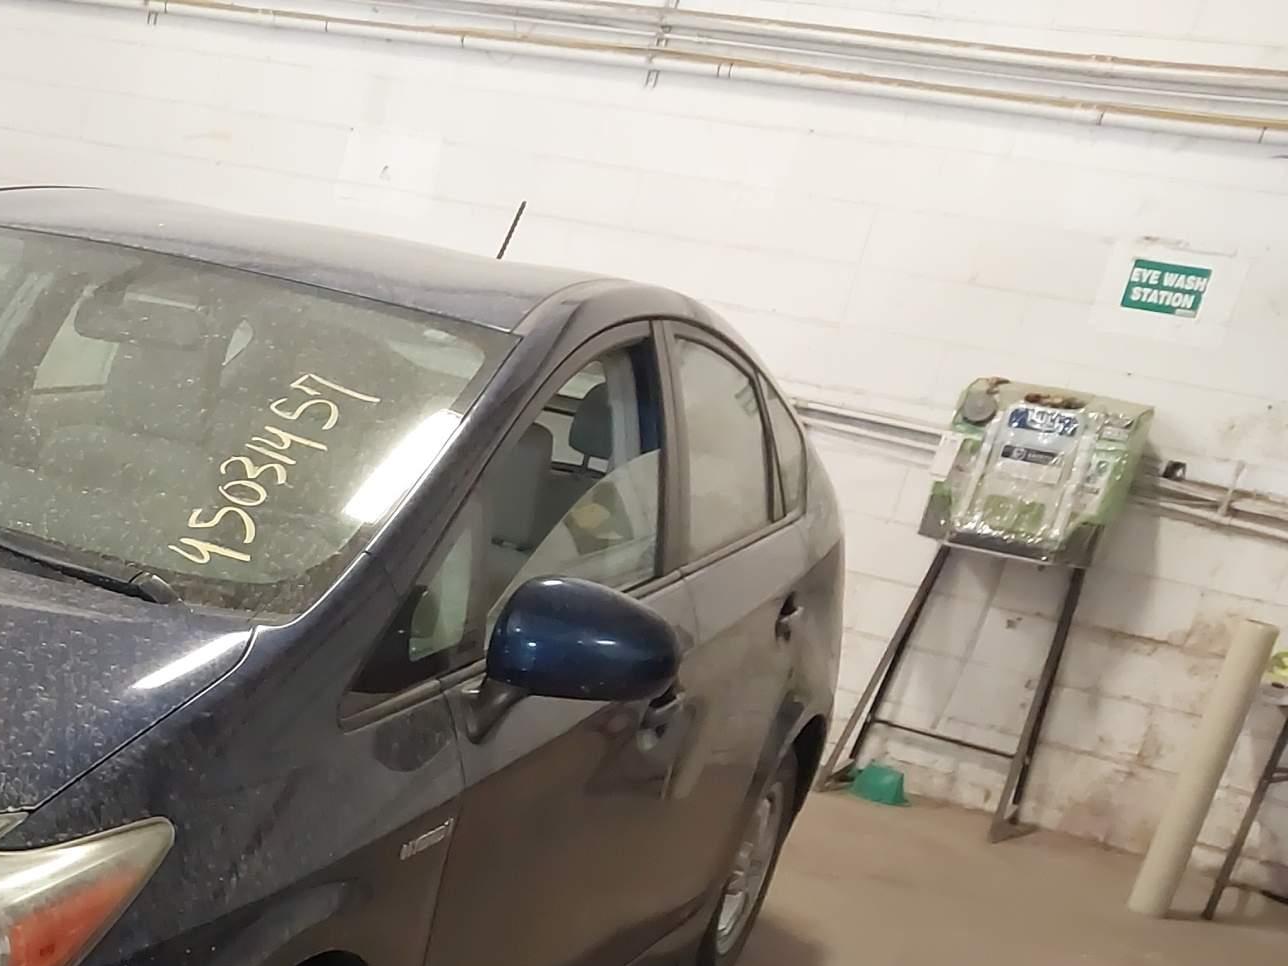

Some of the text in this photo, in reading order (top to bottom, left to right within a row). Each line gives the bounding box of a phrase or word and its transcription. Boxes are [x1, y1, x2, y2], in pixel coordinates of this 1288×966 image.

[1130, 267, 1208, 292] EYE WASH
[1130, 286, 1195, 309] STATION
[167, 373, 381, 564] 45031457
